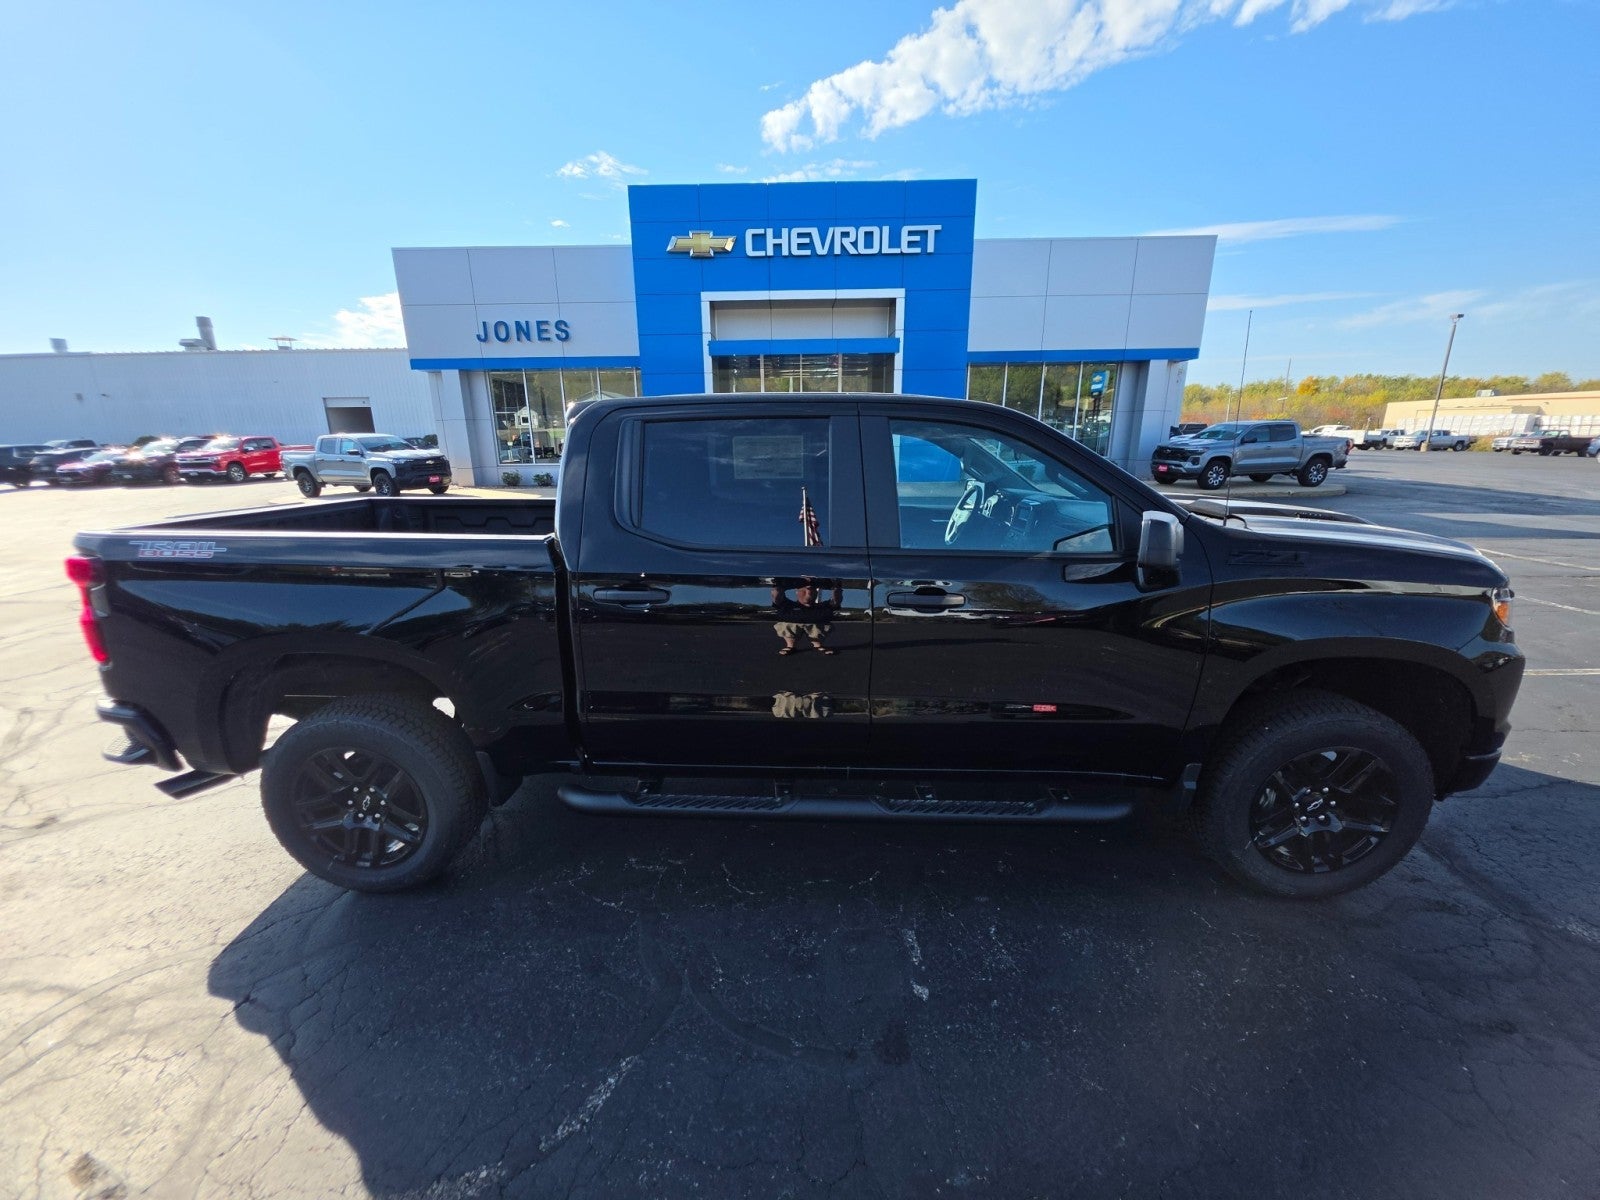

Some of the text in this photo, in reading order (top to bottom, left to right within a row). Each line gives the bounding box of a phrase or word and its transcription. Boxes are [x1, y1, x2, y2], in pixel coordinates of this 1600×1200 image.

[744, 225, 943, 257] CHEVROLET
[476, 319, 570, 342] JONES
[128, 540, 227, 552] TRAIL
[138, 550, 214, 558] BOSS
